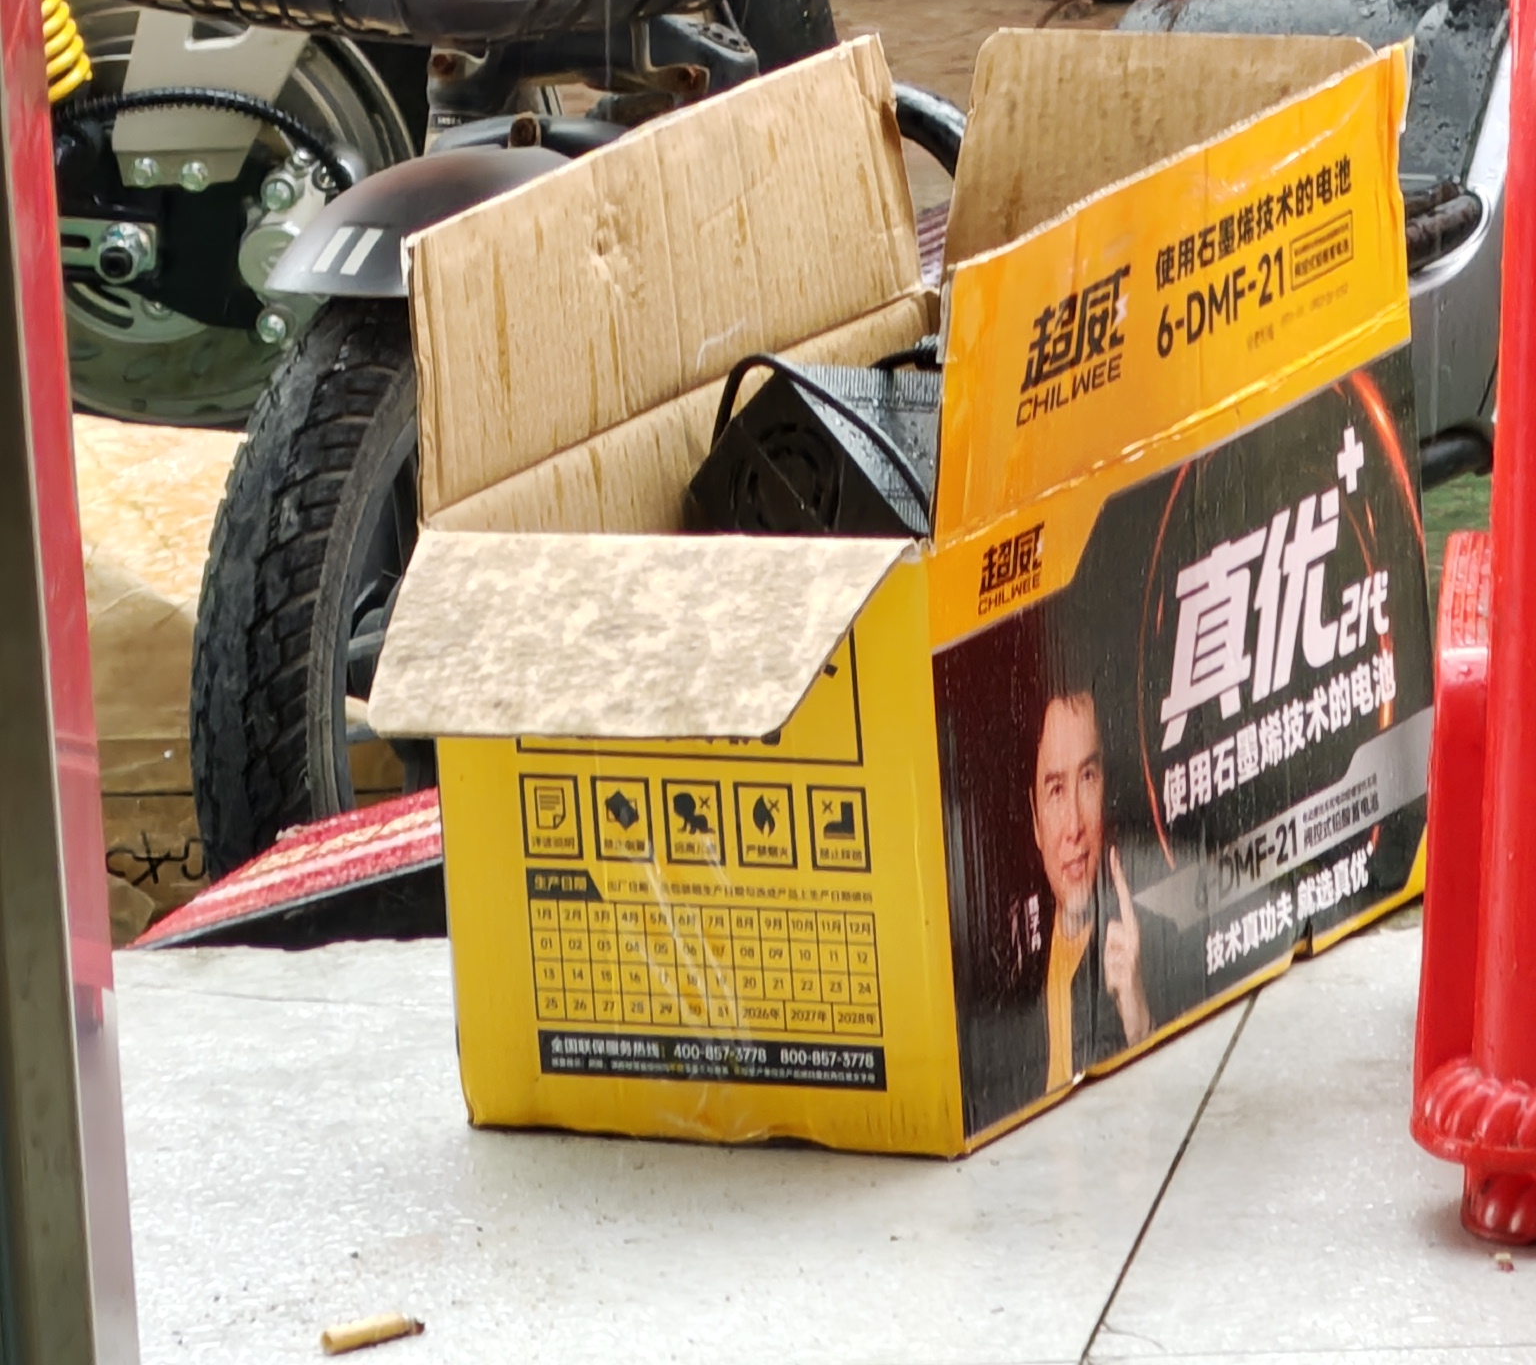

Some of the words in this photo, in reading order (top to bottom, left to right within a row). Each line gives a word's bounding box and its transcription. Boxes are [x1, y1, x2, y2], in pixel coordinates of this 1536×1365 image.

[1155, 154, 1352, 292] 使用石墨烯技术的电池
[1020, 262, 1132, 395] 超威
[1157, 245, 1285, 359] 6-DMF-21
[1016, 352, 1123, 429] CHILWEE
[978, 572, 1041, 615] CHILWEE
[979, 520, 1045, 598] 超威
[1338, 569, 1390, 659] 2代
[1162, 647, 1397, 824] 使用石墨烯技术的电池
[1206, 890, 1295, 976] 技术真功夫
